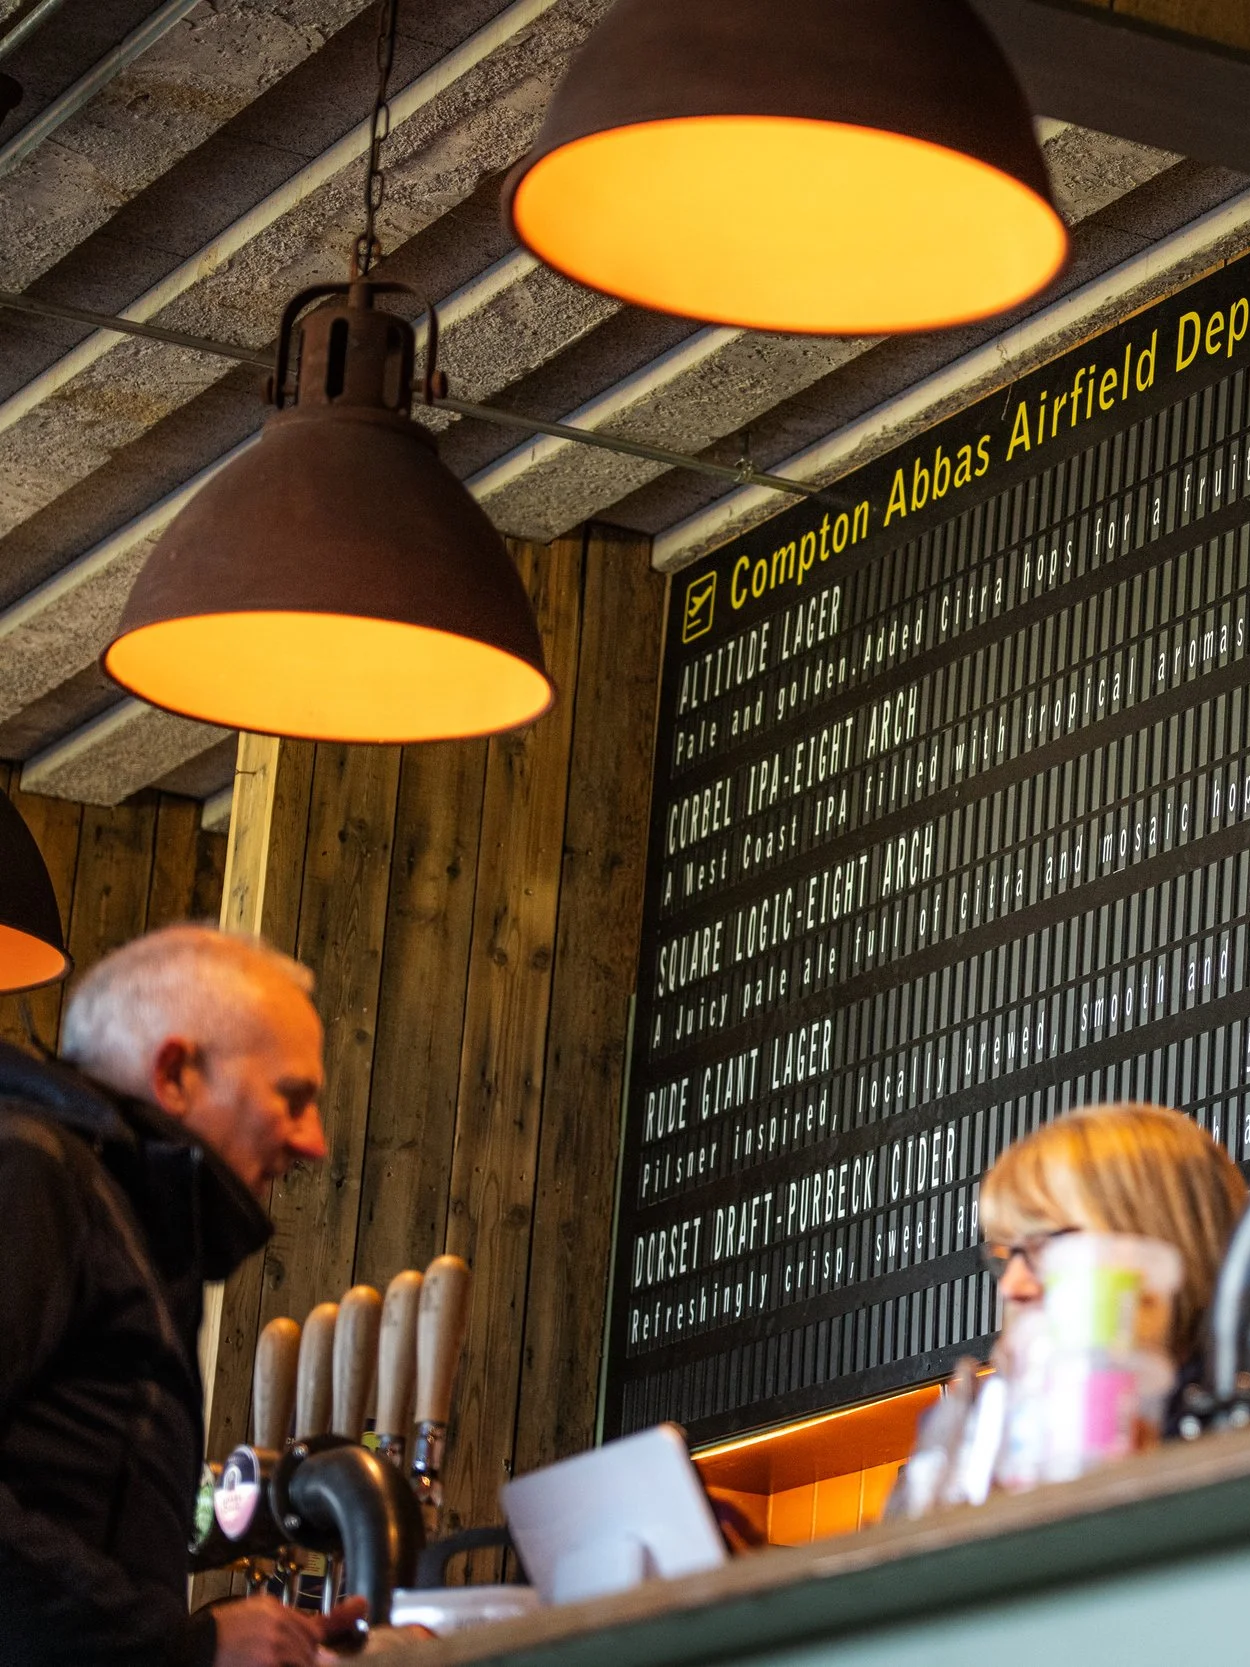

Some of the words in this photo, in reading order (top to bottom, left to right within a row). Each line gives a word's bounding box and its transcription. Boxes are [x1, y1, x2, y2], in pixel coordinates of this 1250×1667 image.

[730, 500, 869, 609] Compton
[883, 434, 990, 527] Abbas
[1005, 328, 1157, 461] Airfield
[675, 719, 717, 765] Pale
[730, 690, 764, 735] and
[940, 577, 1002, 631] Citra
[1022, 540, 1072, 588] hops
[1094, 512, 1130, 555] for
[1151, 497, 1160, 525] a
[679, 622, 769, 713] ALTITUDE
[781, 585, 840, 658] LAGER
[663, 870, 672, 906] A
[742, 814, 796, 869] Coast
[814, 788, 846, 835] IPA
[864, 745, 938, 812] filled
[955, 716, 1005, 770] with
[1026, 657, 1134, 738] tropical
[1156, 618, 1243, 680] aromas
[668, 777, 731, 854] CORBEL
[747, 718, 853, 814] IPA-EIGHT
[866, 686, 917, 758] ARCH
[652, 1013, 661, 1049] A
[675, 993, 728, 1040] Juicy
[742, 966, 786, 1017] pale
[802, 942, 835, 984] ale
[854, 910, 900, 962] full
[918, 893, 941, 936] of
[959, 868, 1023, 919] citra
[1044, 834, 1083, 884] and
[1101, 803, 1188, 862] mosaic
[657, 921, 722, 996] SQUARE
[735, 856, 867, 959] LOGIC-EIGHT
[881, 825, 933, 896] ARCH
[641, 1142, 717, 1197] Pilsner
[733, 1089, 837, 1159] inspired,
[858, 1052, 945, 1112] locally
[964, 1011, 1056, 1075] brewed,
[1080, 965, 1164, 1031] smooth
[1186, 938, 1229, 991] and
[645, 1077, 689, 1141] RUDE
[701, 1048, 758, 1119] GIANT
[772, 1019, 831, 1088] LAGER
[631, 1271, 767, 1343] Refreshingly
[784, 1247, 854, 1292] crisp,
[875, 1209, 936, 1261] sweet
[634, 1217, 701, 1286] DORSET
[714, 1156, 873, 1258] DRAFT-PURBECK
[890, 1127, 955, 1199] CIDER
